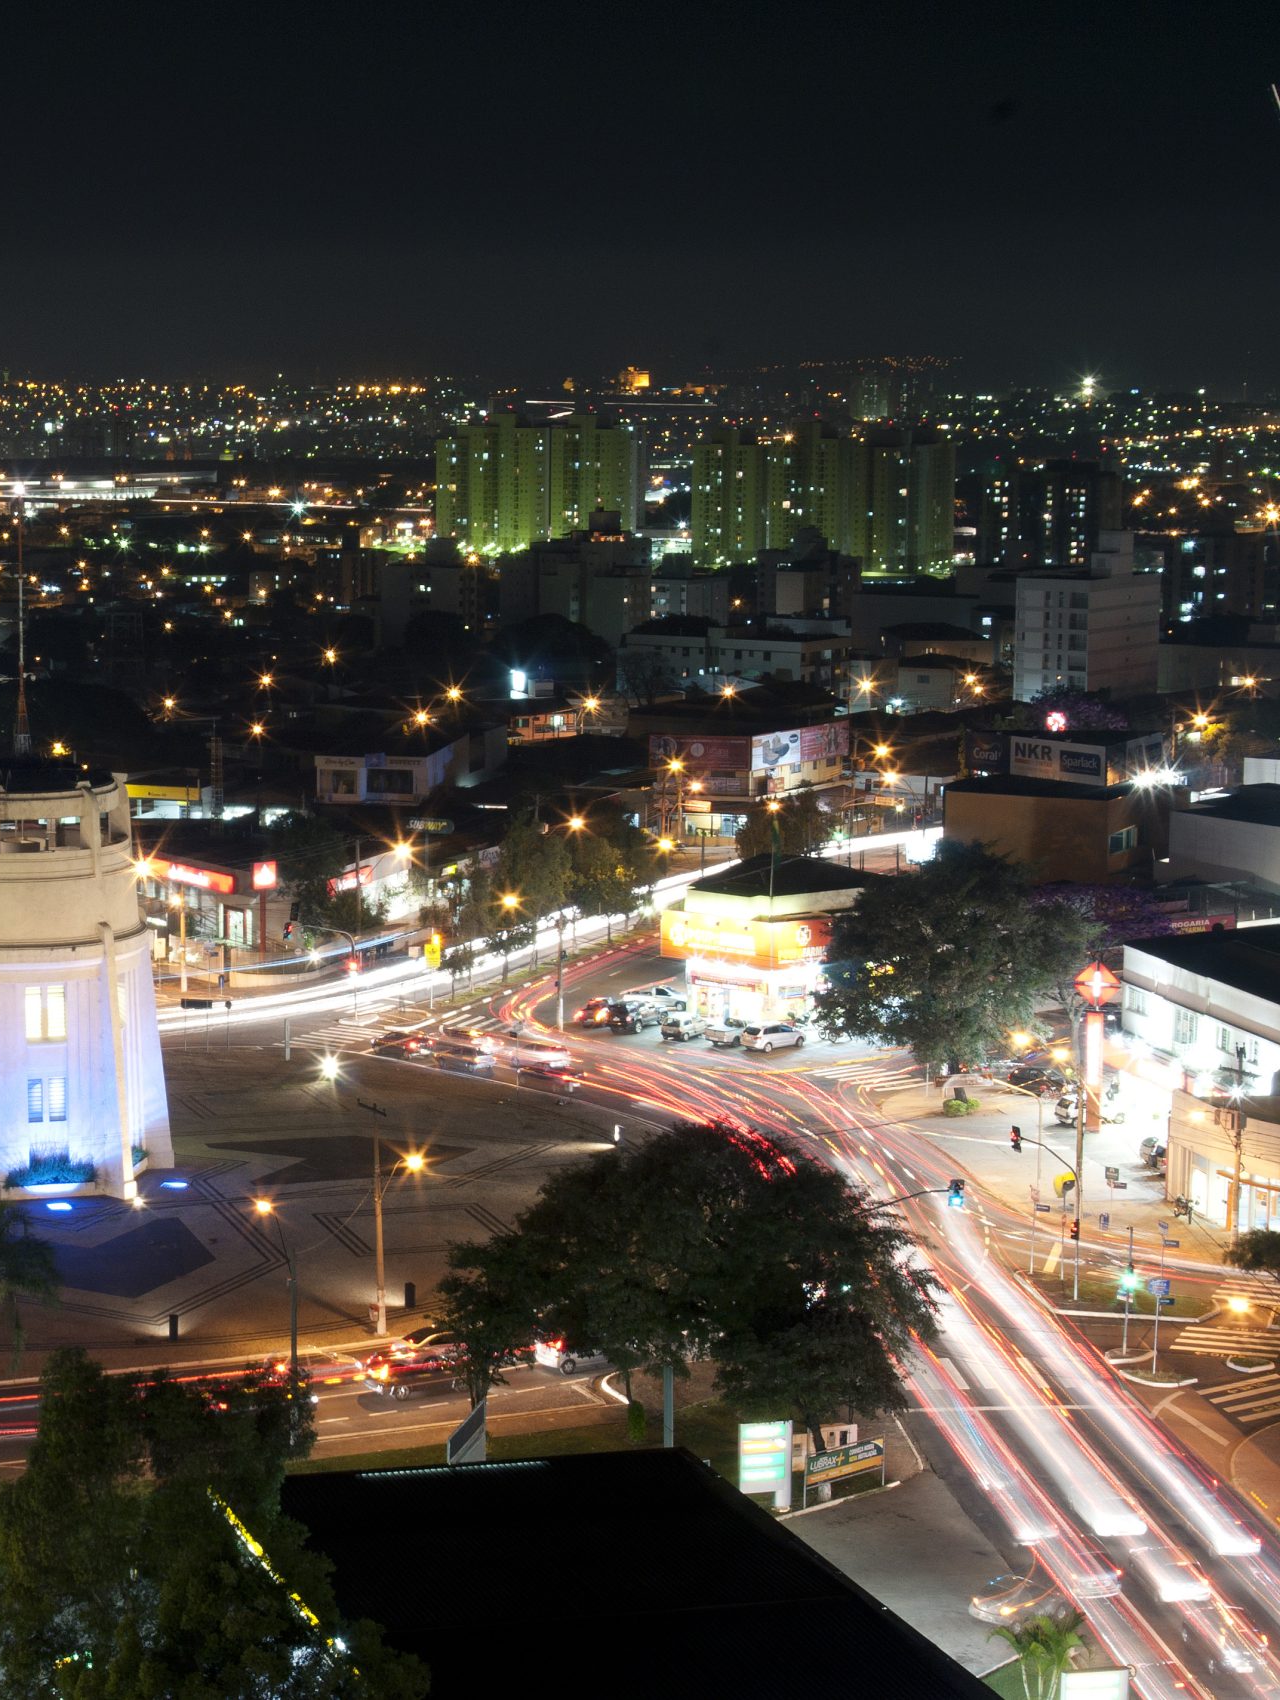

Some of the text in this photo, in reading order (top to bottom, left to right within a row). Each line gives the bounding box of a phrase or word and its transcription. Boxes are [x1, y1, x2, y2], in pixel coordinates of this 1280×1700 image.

[973, 747, 998, 761] Coral
[1015, 742, 1052, 761] NKR
[1062, 754, 1098, 769] Sparlack
[407, 819, 445, 831] SUBWAY
